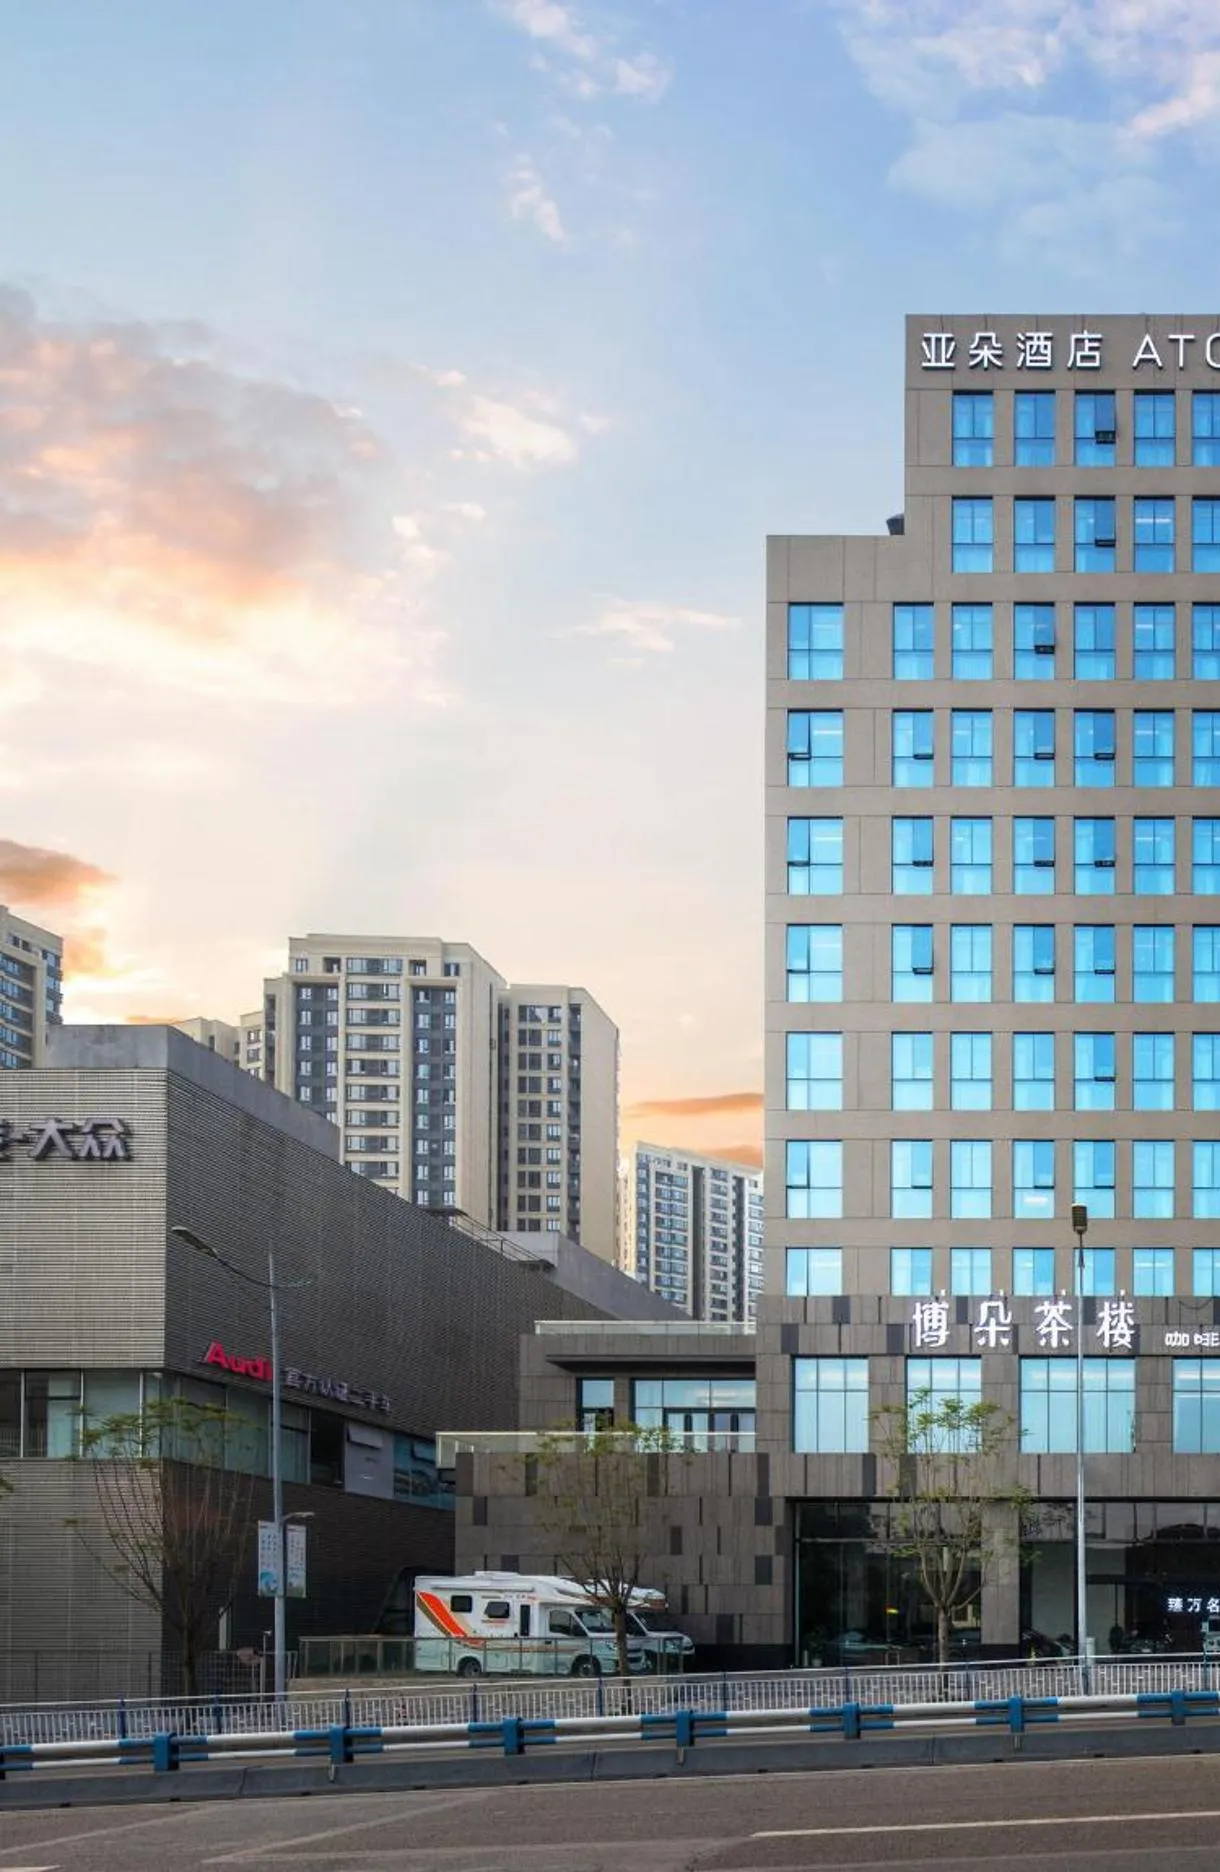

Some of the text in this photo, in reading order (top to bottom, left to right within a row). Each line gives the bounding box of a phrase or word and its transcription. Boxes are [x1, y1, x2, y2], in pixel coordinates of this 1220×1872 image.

[920, 330, 1104, 369] 亚朵酒店
[0, 1117, 127, 1158] -大众
[911, 1300, 1137, 1349] 博朵茶楼
[1164, 1331, 1220, 1347] 咖啡
[203, 1340, 274, 1382] Audi
